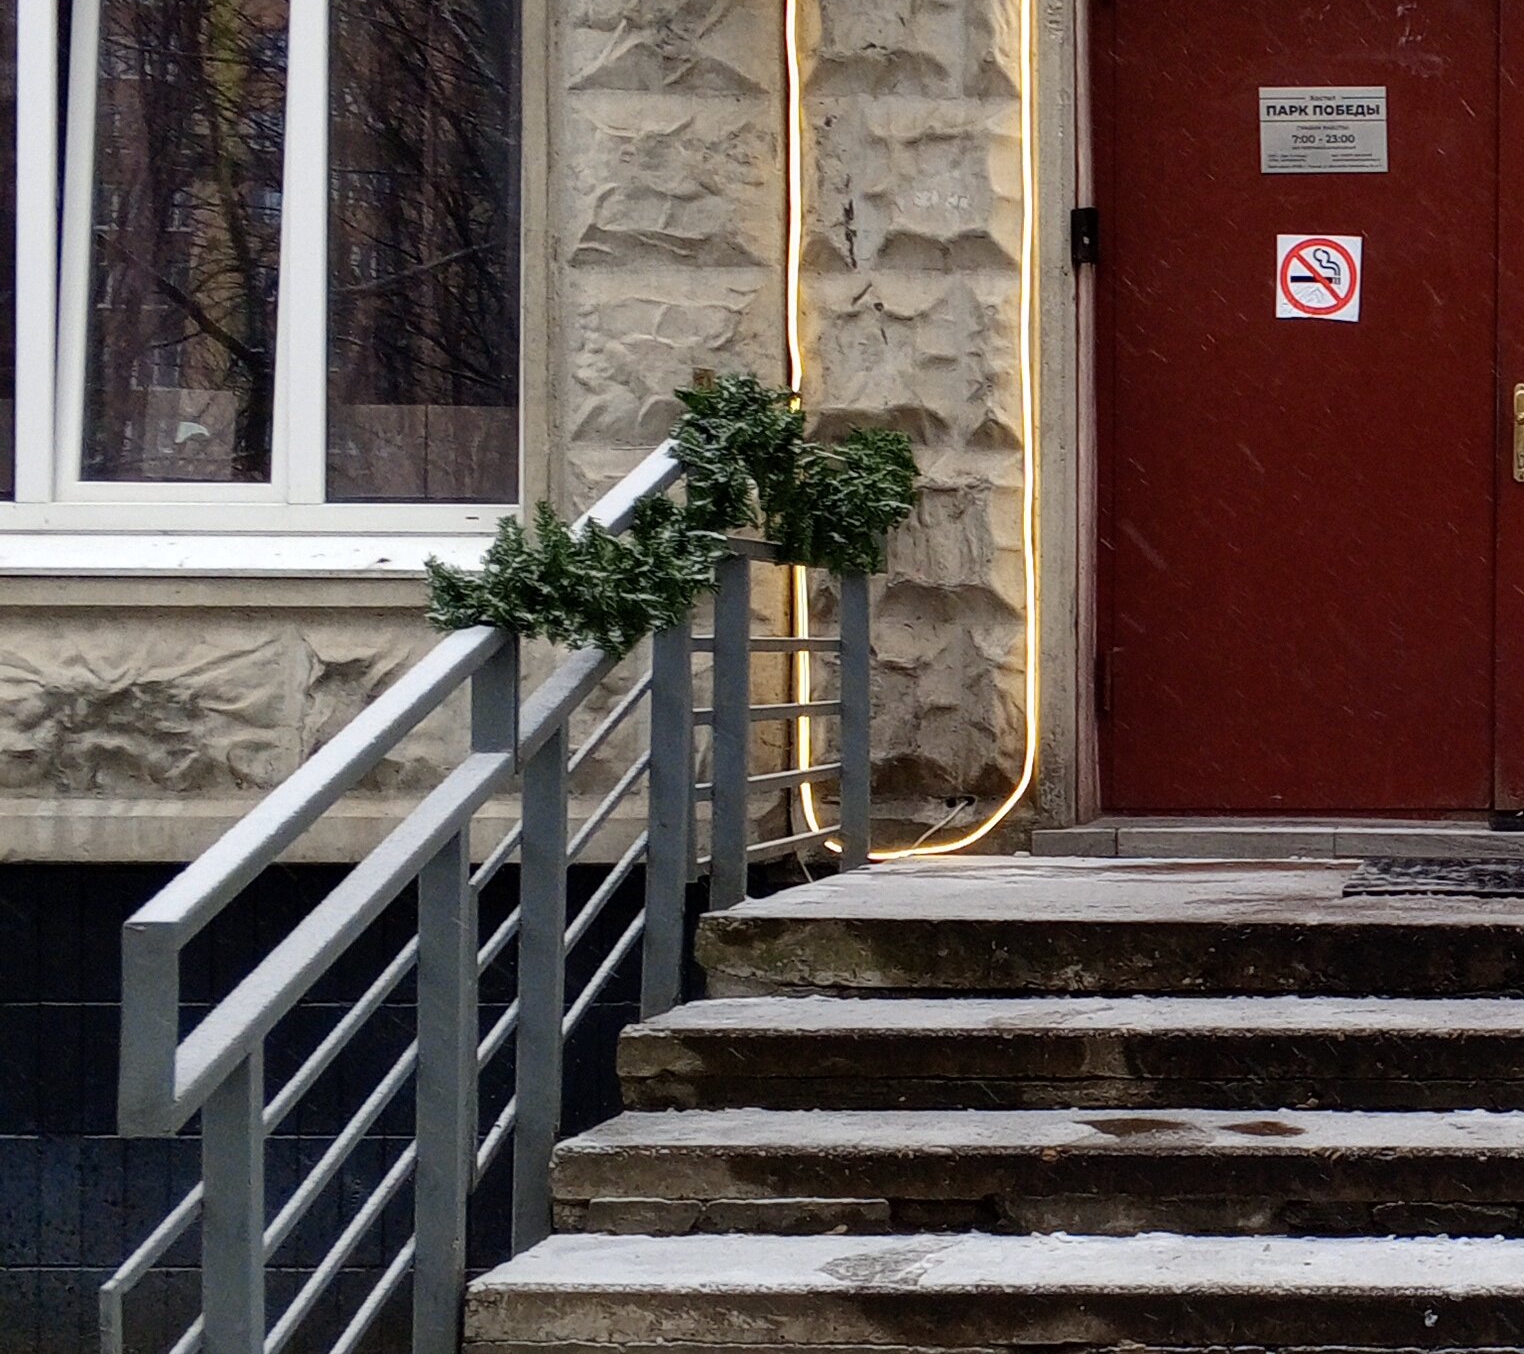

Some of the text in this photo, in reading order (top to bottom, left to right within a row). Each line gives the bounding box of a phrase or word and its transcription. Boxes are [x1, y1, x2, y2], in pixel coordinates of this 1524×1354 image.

[1266, 104, 1380, 117] ПАРК ПОБЕДЫ
[1292, 134, 1316, 144] 7:00
[1325, 134, 1355, 144] 23:00
